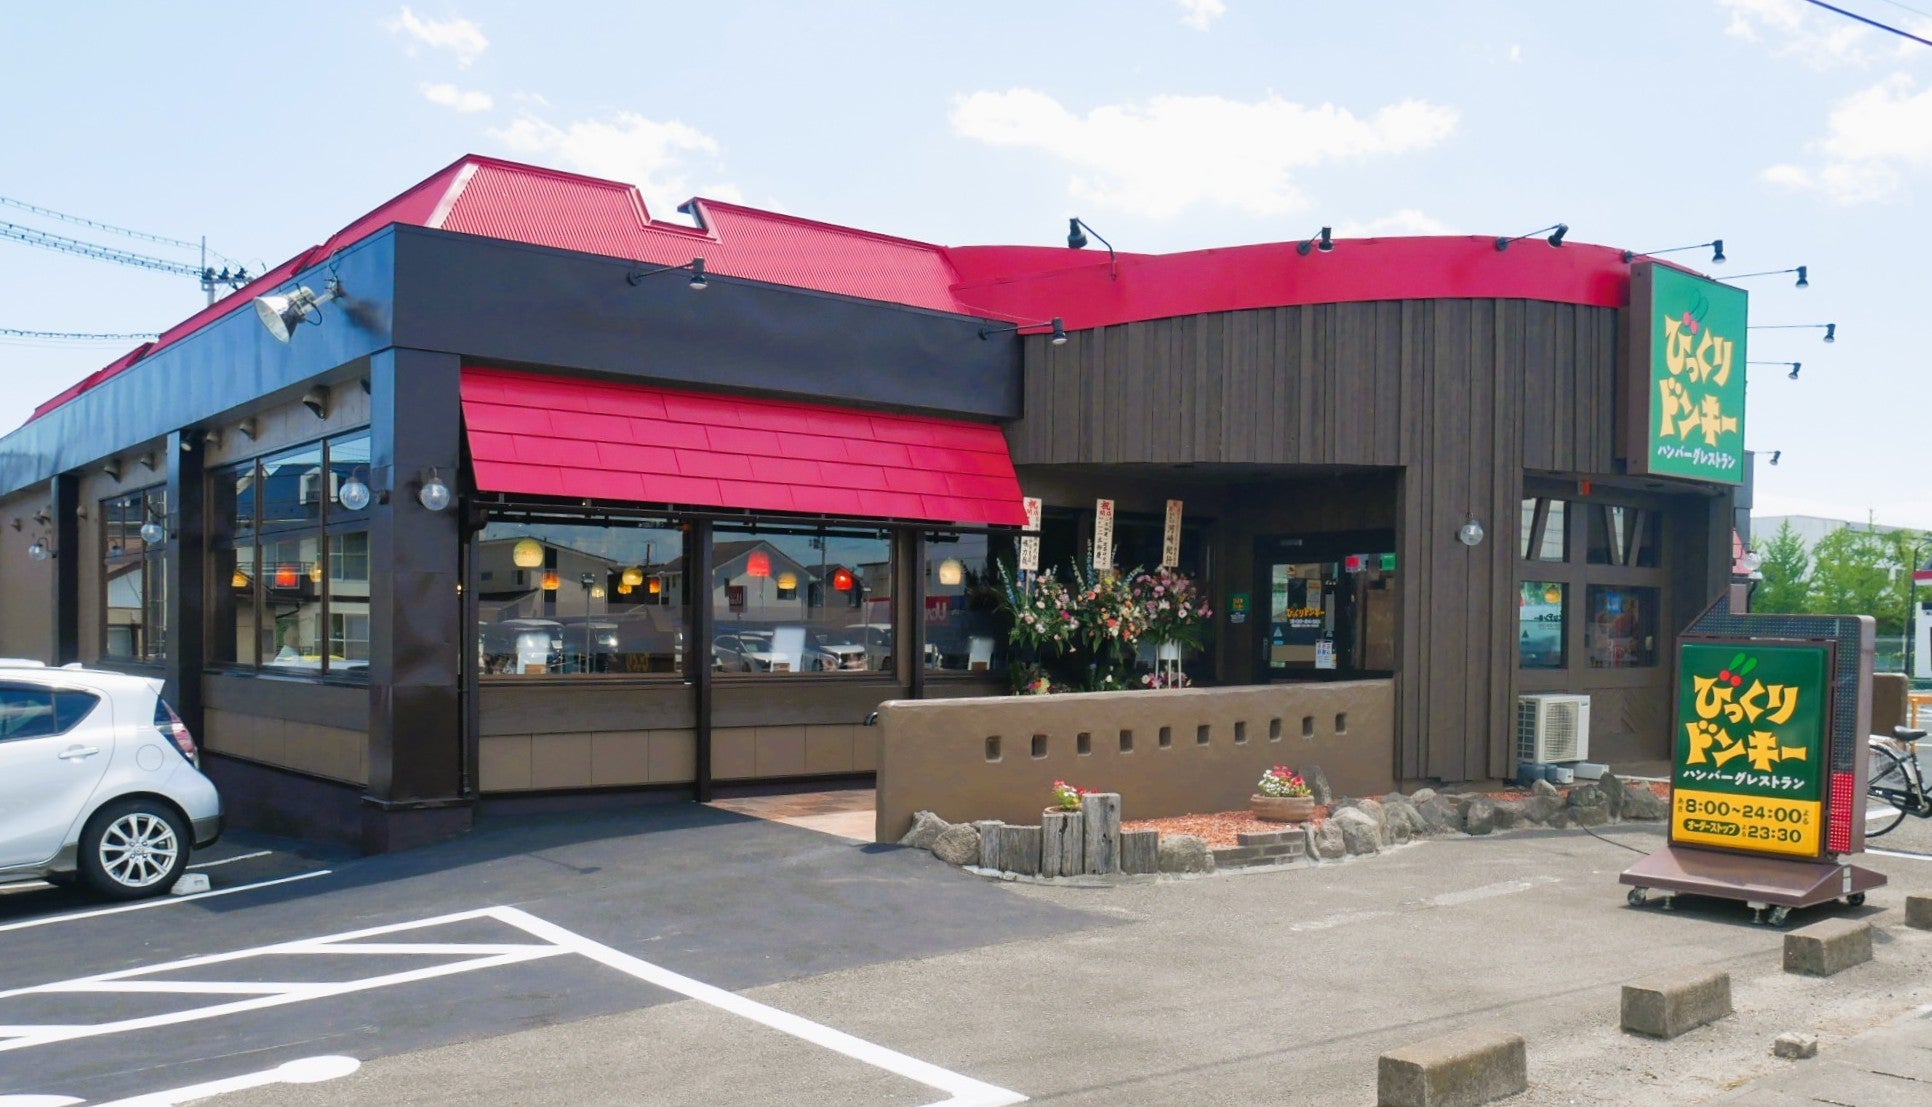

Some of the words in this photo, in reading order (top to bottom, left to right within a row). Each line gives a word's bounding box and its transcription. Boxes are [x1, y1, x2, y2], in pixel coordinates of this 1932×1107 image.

[1664, 314, 1733, 387] びっくり
[1659, 377, 1738, 447] ドンキー
[1657, 445, 1735, 469] ハンバーグレストラン
[1693, 675, 1799, 725] びっくり
[1685, 720, 1807, 773] ドンキー
[1683, 769, 1806, 790] ハンバーグレストラン
[1687, 820, 1736, 834] オーダーストップ
[1748, 825, 1802, 843] 23:30
